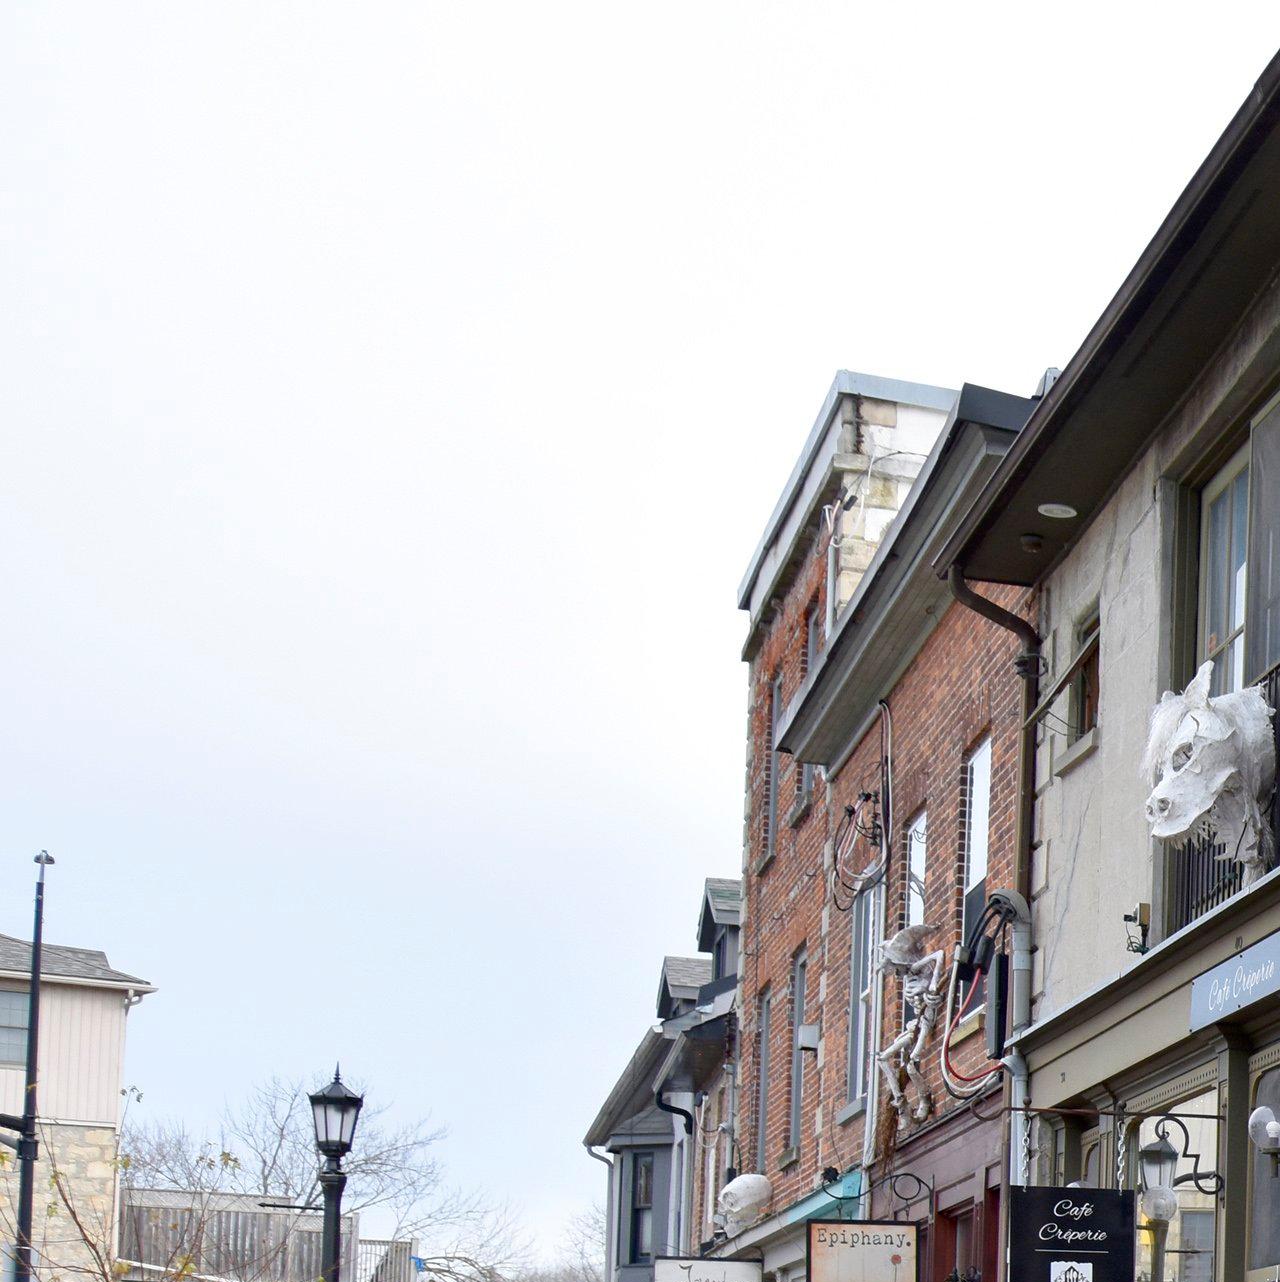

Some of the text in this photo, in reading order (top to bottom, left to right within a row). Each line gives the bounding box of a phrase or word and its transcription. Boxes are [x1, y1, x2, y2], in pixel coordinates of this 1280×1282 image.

[1053, 1199, 1094, 1220] Café
[817, 1228, 911, 1248] Epiphany.
[1038, 1222, 1107, 1243] Crêperie
